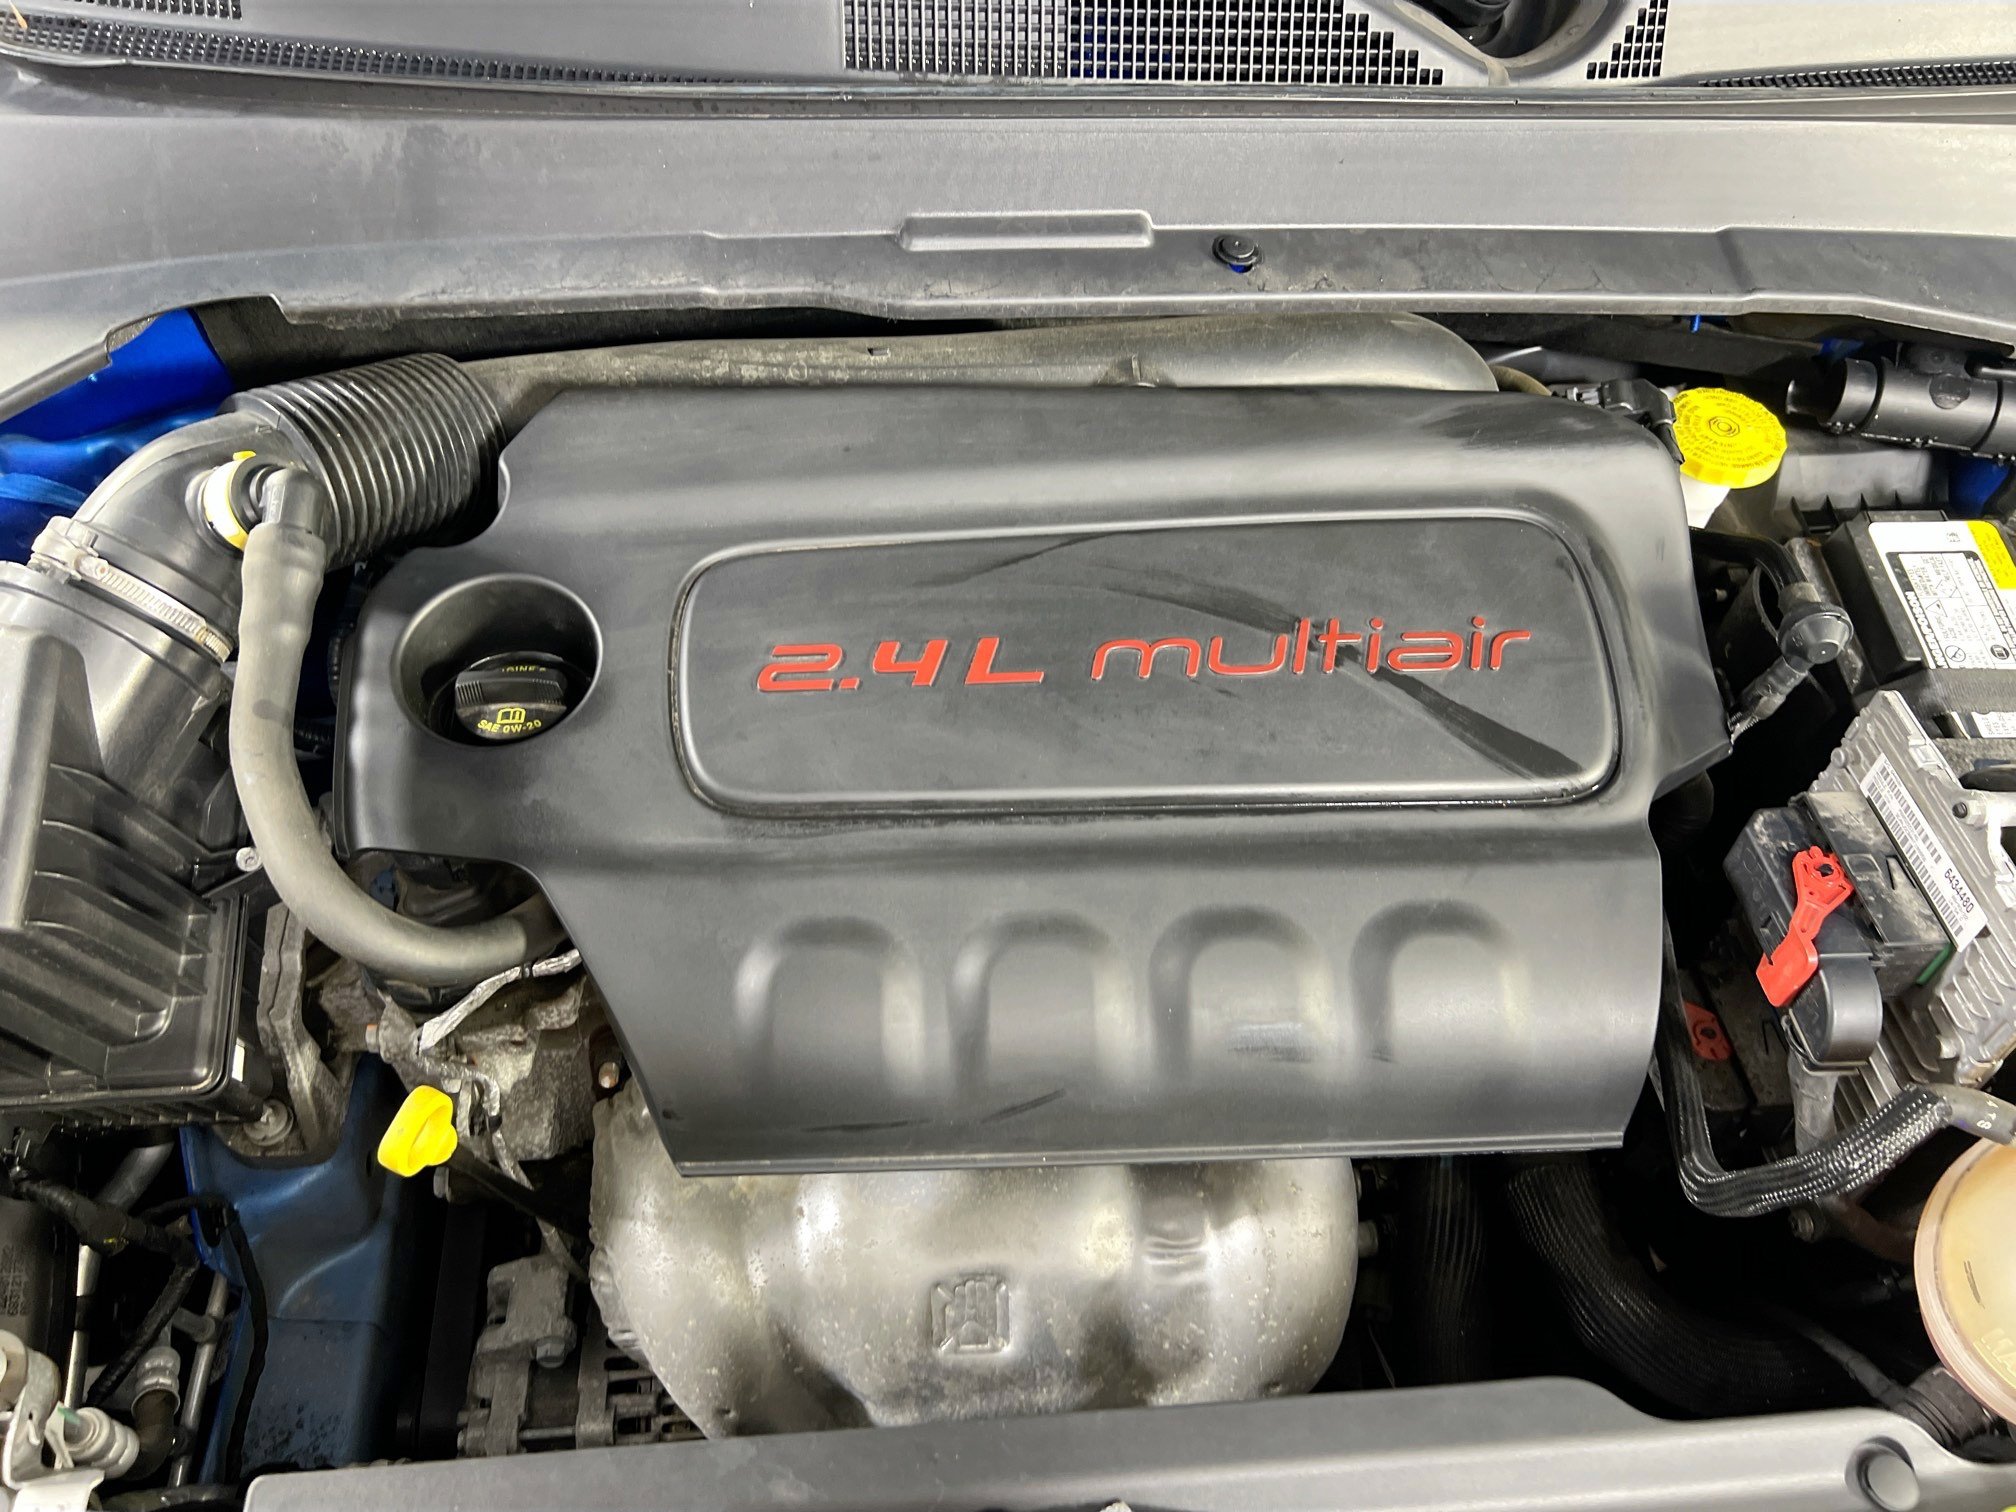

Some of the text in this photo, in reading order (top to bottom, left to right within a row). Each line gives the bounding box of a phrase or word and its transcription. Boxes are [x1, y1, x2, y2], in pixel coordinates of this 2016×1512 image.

[757, 615, 1531, 692] 2.4L multiair
[477, 719, 542, 733] SAE 0W-20
[1944, 868, 1974, 914] 6434480
